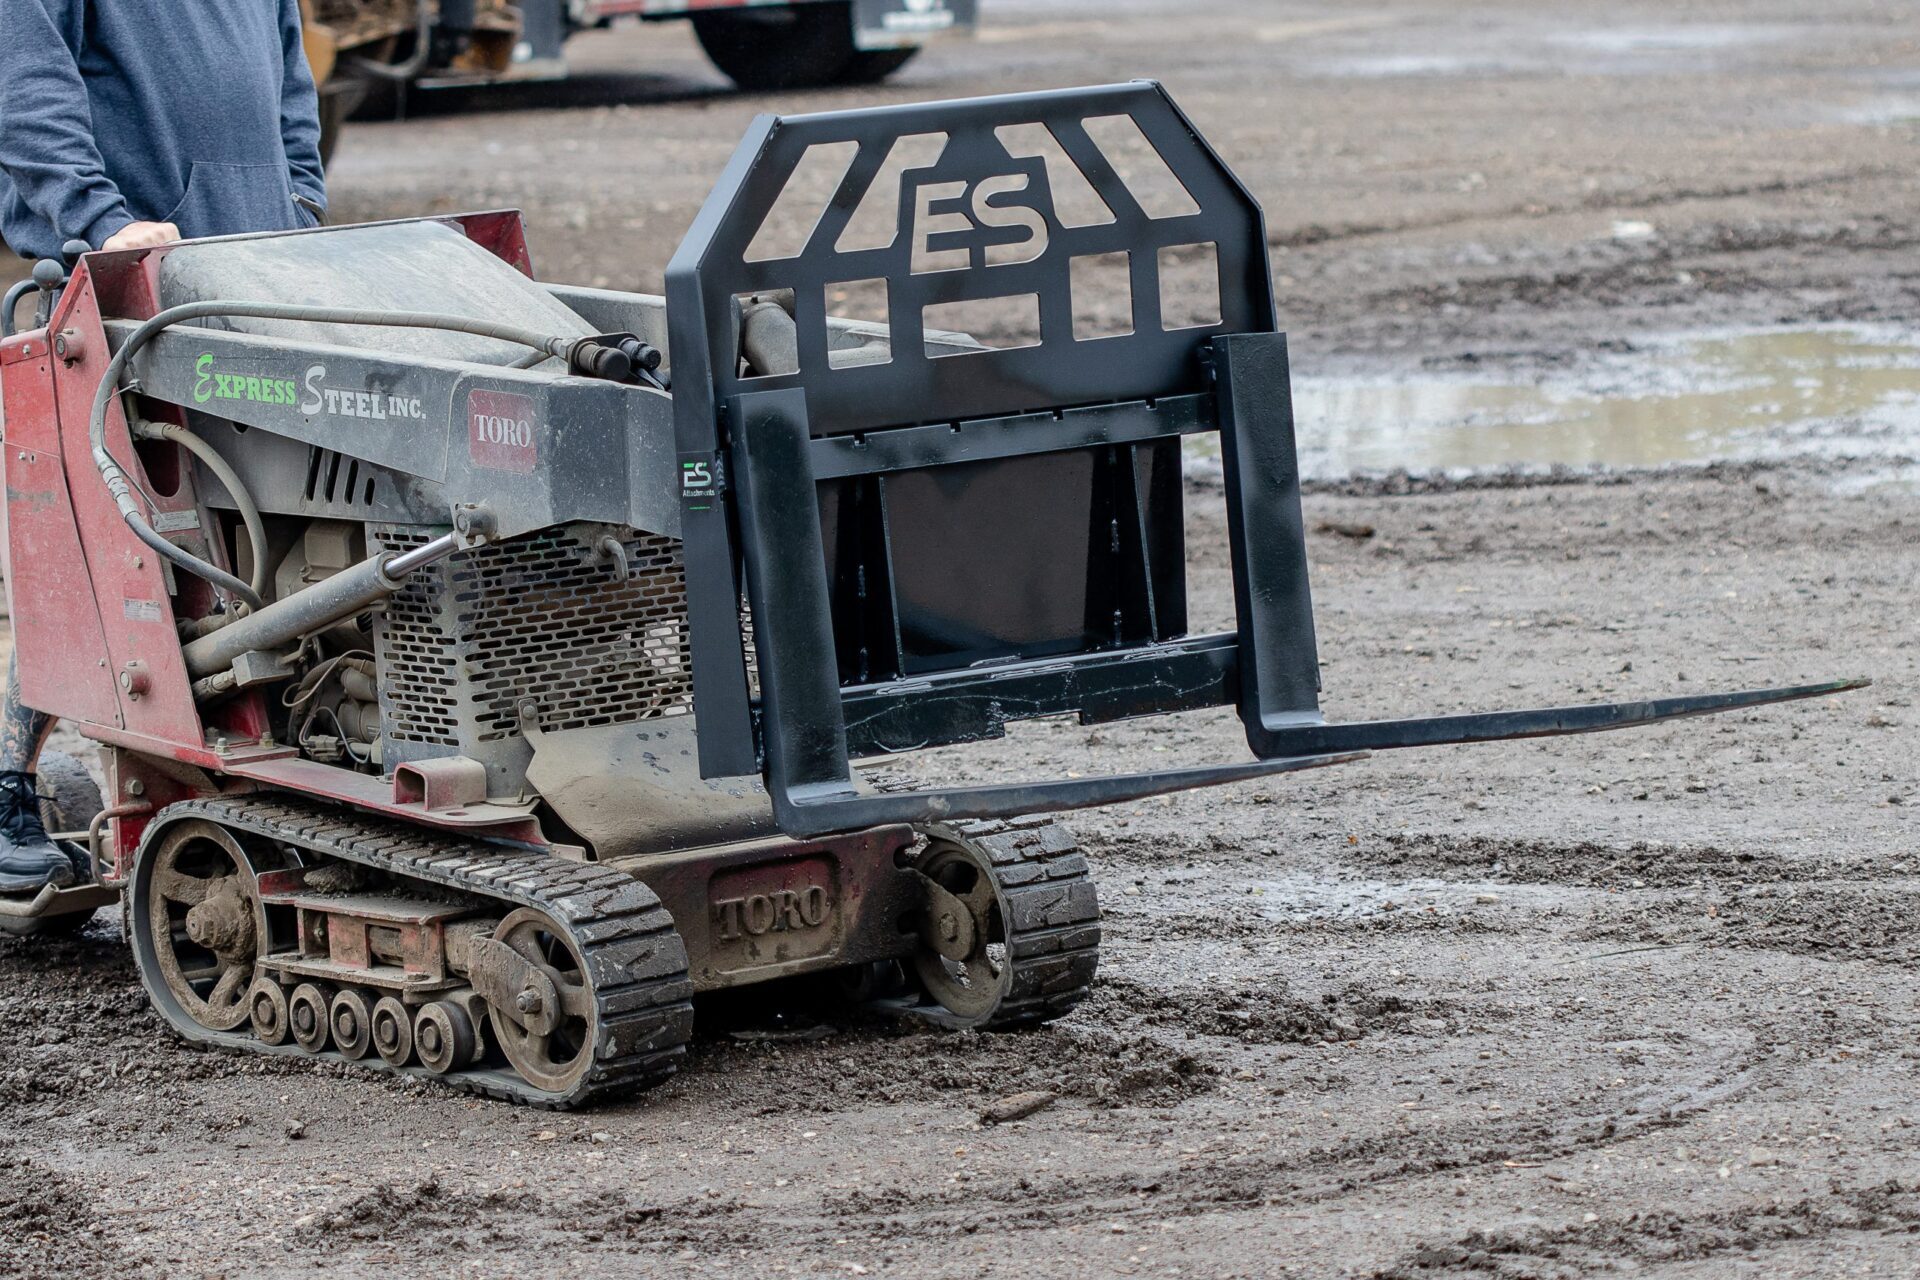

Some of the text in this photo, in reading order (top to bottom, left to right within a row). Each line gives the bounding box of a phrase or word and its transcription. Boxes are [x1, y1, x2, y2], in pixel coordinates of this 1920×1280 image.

[910, 173, 1049, 275] ES
[194, 353, 427, 420] EXPRESS STEEL INC.
[473, 413, 532, 448] TORO
[683, 462, 712, 488] ES
[714, 885, 831, 939] TORO
